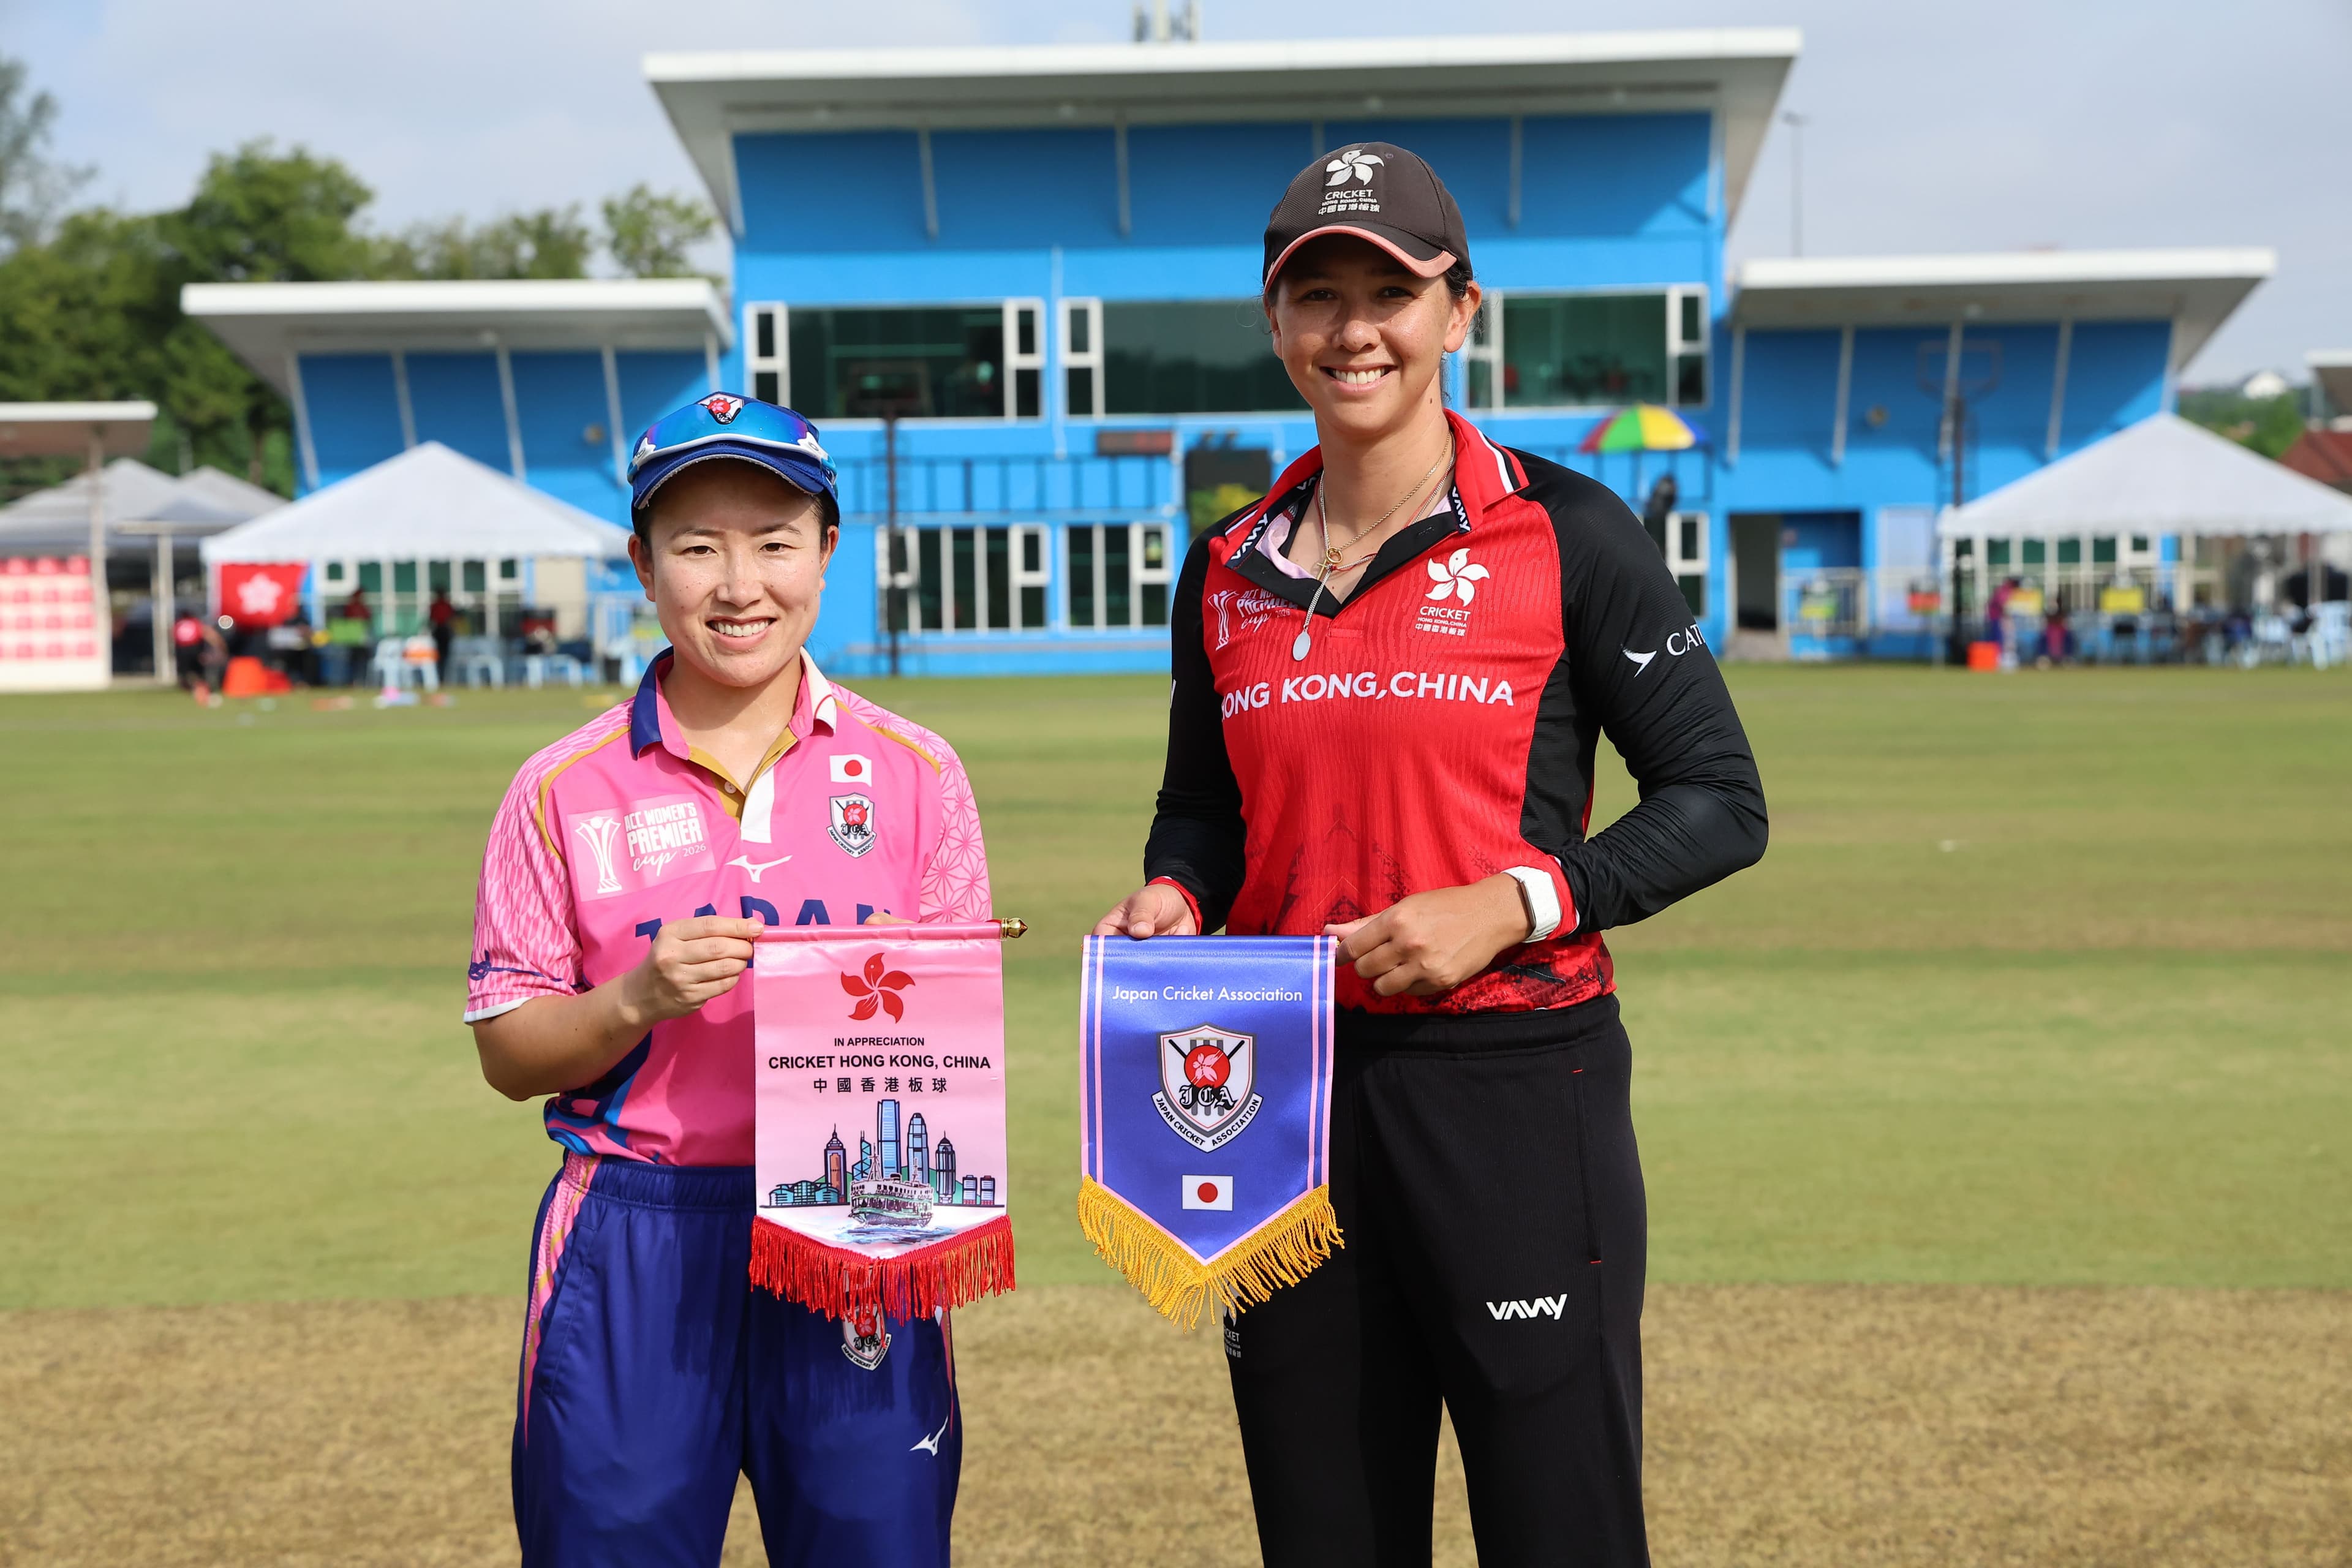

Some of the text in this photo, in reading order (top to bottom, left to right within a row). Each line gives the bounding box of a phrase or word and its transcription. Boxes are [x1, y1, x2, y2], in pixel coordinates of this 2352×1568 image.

[1325, 189, 1373, 200] CRICKET
[1241, 609, 1291, 633] cup 2026
[1420, 606, 1471, 621] CRICKET
[624, 802, 697, 832] ACC WOMEN'S
[627, 818, 703, 858] PREMIER
[633, 843, 706, 876] cup 2026
[1112, 986, 1303, 1003] Japan Cricket Association
[834, 1037, 925, 1046] IN APPRECIATION
[769, 1055, 991, 1071] CRICKET HONG KONG, CHINA
[813, 1077, 947, 1093] 中國香港板球
[1156, 1097, 1260, 1147] JAPAN CRICKET ASSOCIATION
